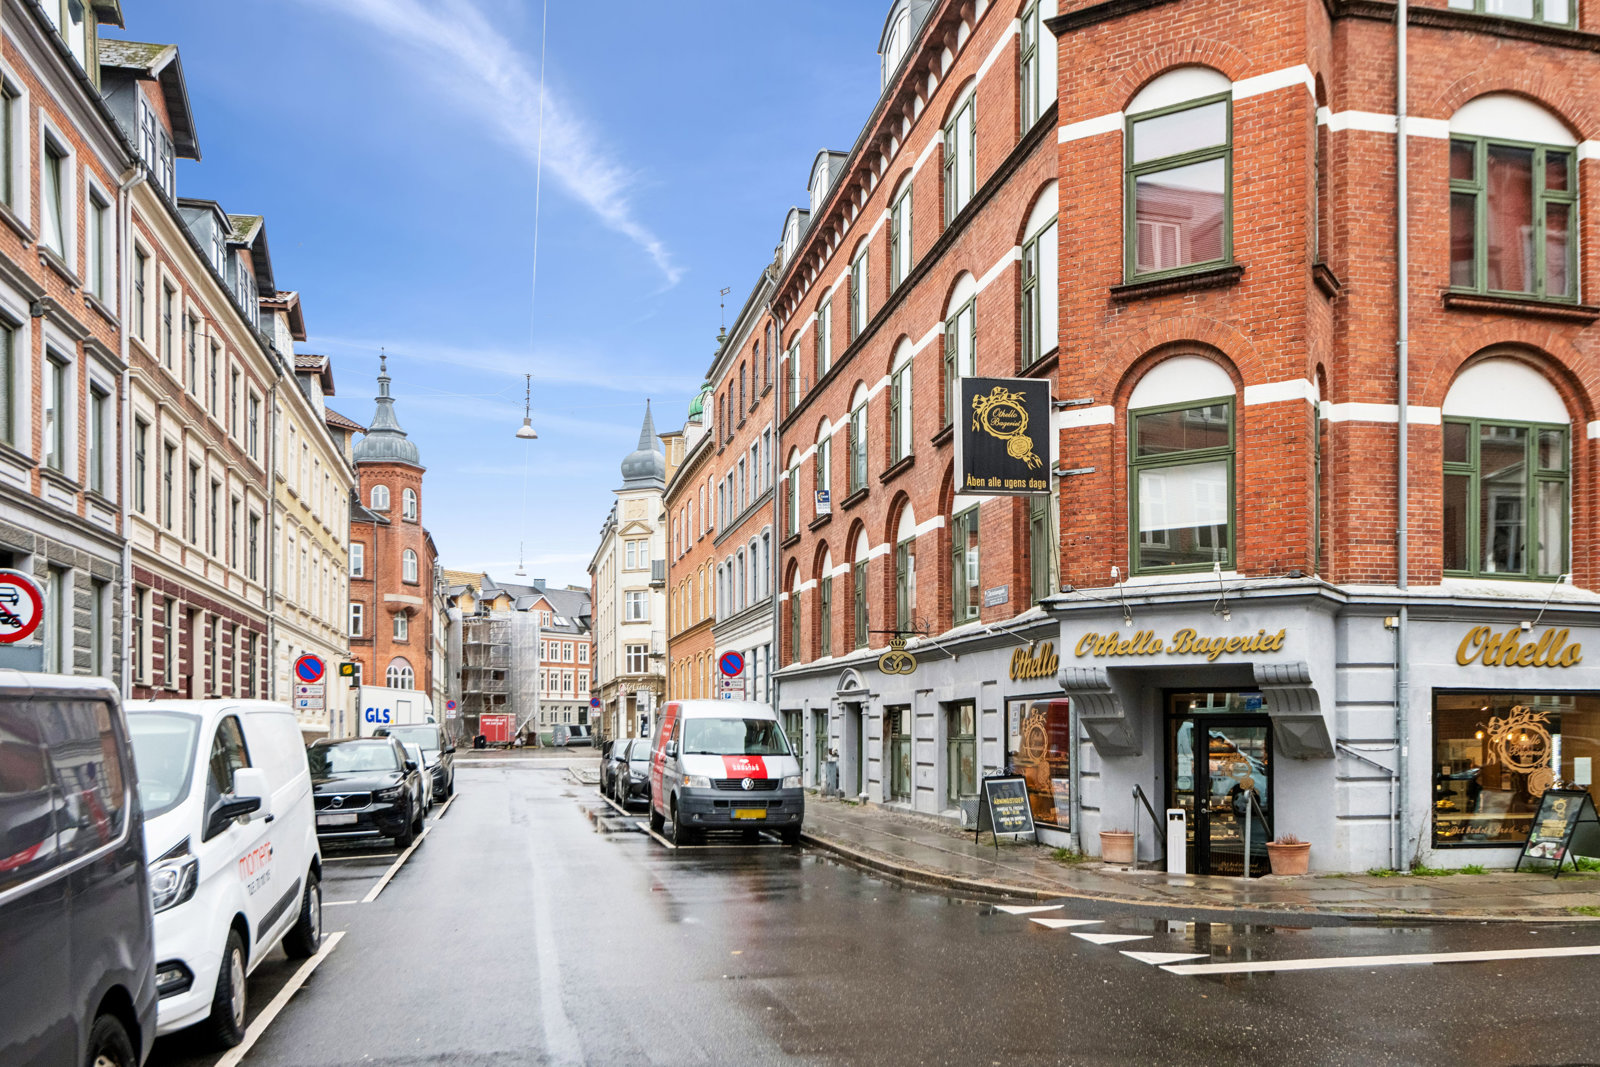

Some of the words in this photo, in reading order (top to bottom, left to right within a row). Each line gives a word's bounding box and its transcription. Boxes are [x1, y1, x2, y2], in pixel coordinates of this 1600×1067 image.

[990, 418, 1020, 428] Bageriet
[993, 408, 1018, 417] Othello
[966, 473, 985, 487] Åben
[988, 476, 1001, 487] alle
[1004, 479, 1026, 489] ugens
[1029, 478, 1046, 489] dage
[1074, 630, 1163, 657] Othello
[1166, 628, 1286, 662] Bageriet
[1456, 626, 1583, 667] Othello
[1009, 640, 1058, 681] Othello
